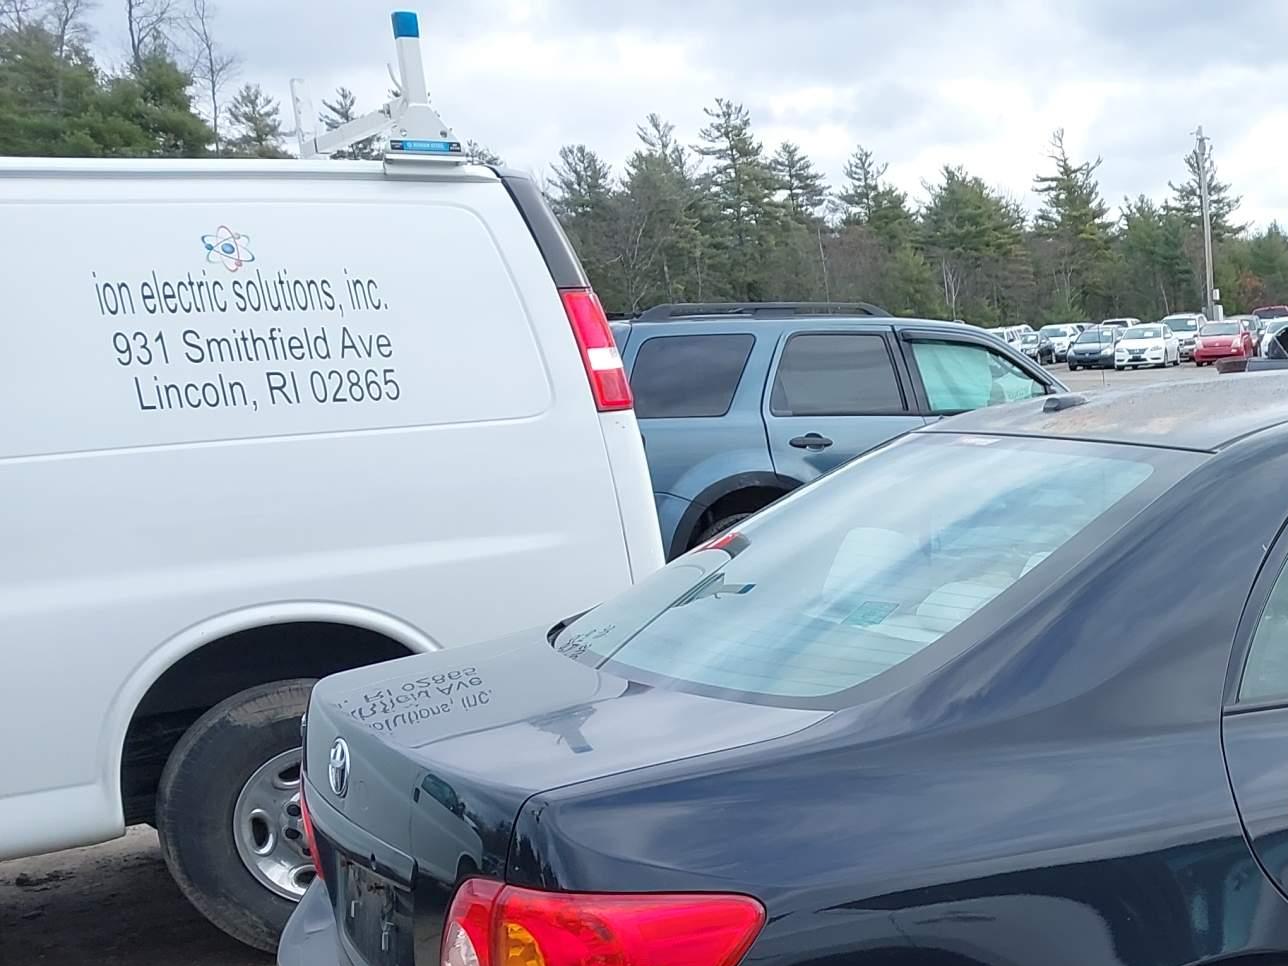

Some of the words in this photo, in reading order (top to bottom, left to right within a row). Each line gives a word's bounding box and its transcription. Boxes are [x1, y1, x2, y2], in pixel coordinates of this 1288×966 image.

[92, 271, 136, 316] ion
[141, 269, 228, 315] electric
[232, 268, 344, 317] solutions,
[343, 268, 388, 311] inc.
[112, 330, 169, 366] 931
[182, 326, 331, 364] Smithfield
[341, 326, 393, 359] Ave
[134, 373, 258, 412] Lincoln,
[265, 370, 301, 405] RI
[310, 368, 400, 404] 02865
